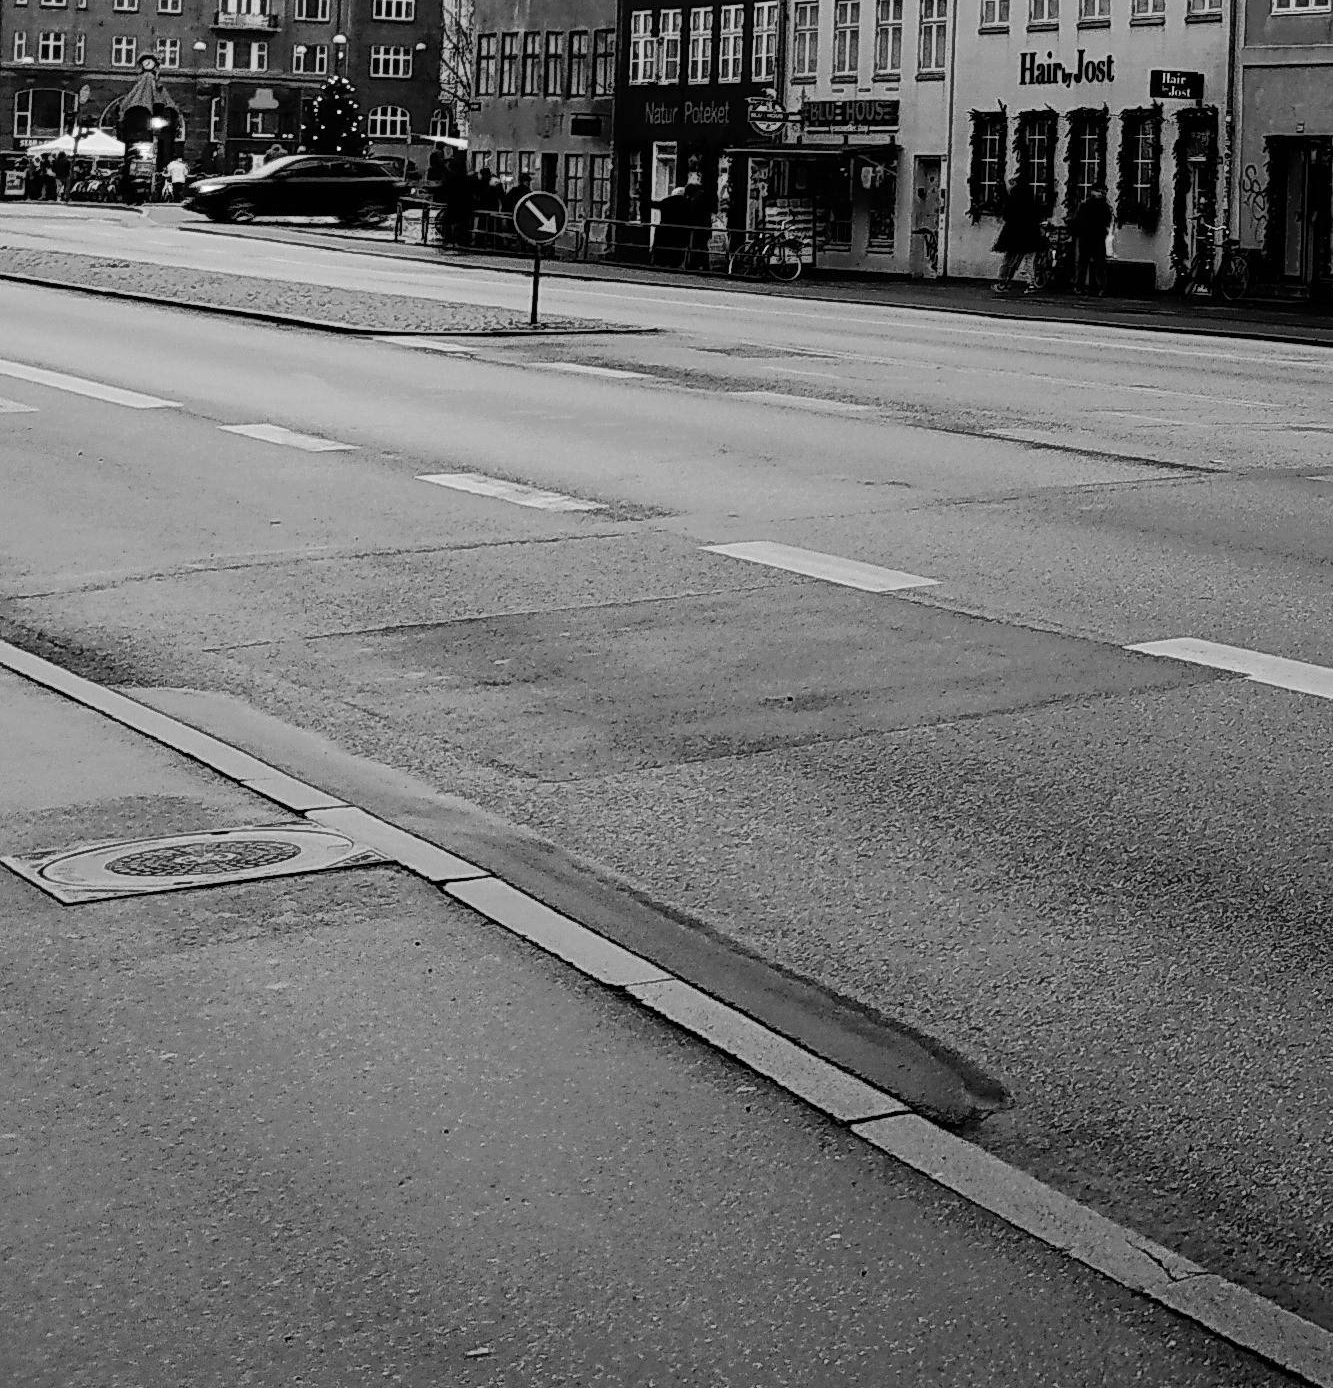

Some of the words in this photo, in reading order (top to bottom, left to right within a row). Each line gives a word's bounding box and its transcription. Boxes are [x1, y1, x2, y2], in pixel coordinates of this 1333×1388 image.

[1019, 50, 1063, 85] Hair
[1062, 65, 1073, 88] by
[1074, 49, 1115, 84] Jost
[1162, 72, 1187, 85] Hair
[1168, 85, 1191, 98] Jost
[645, 101, 678, 125] Natur
[684, 100, 730, 125] Poteket
